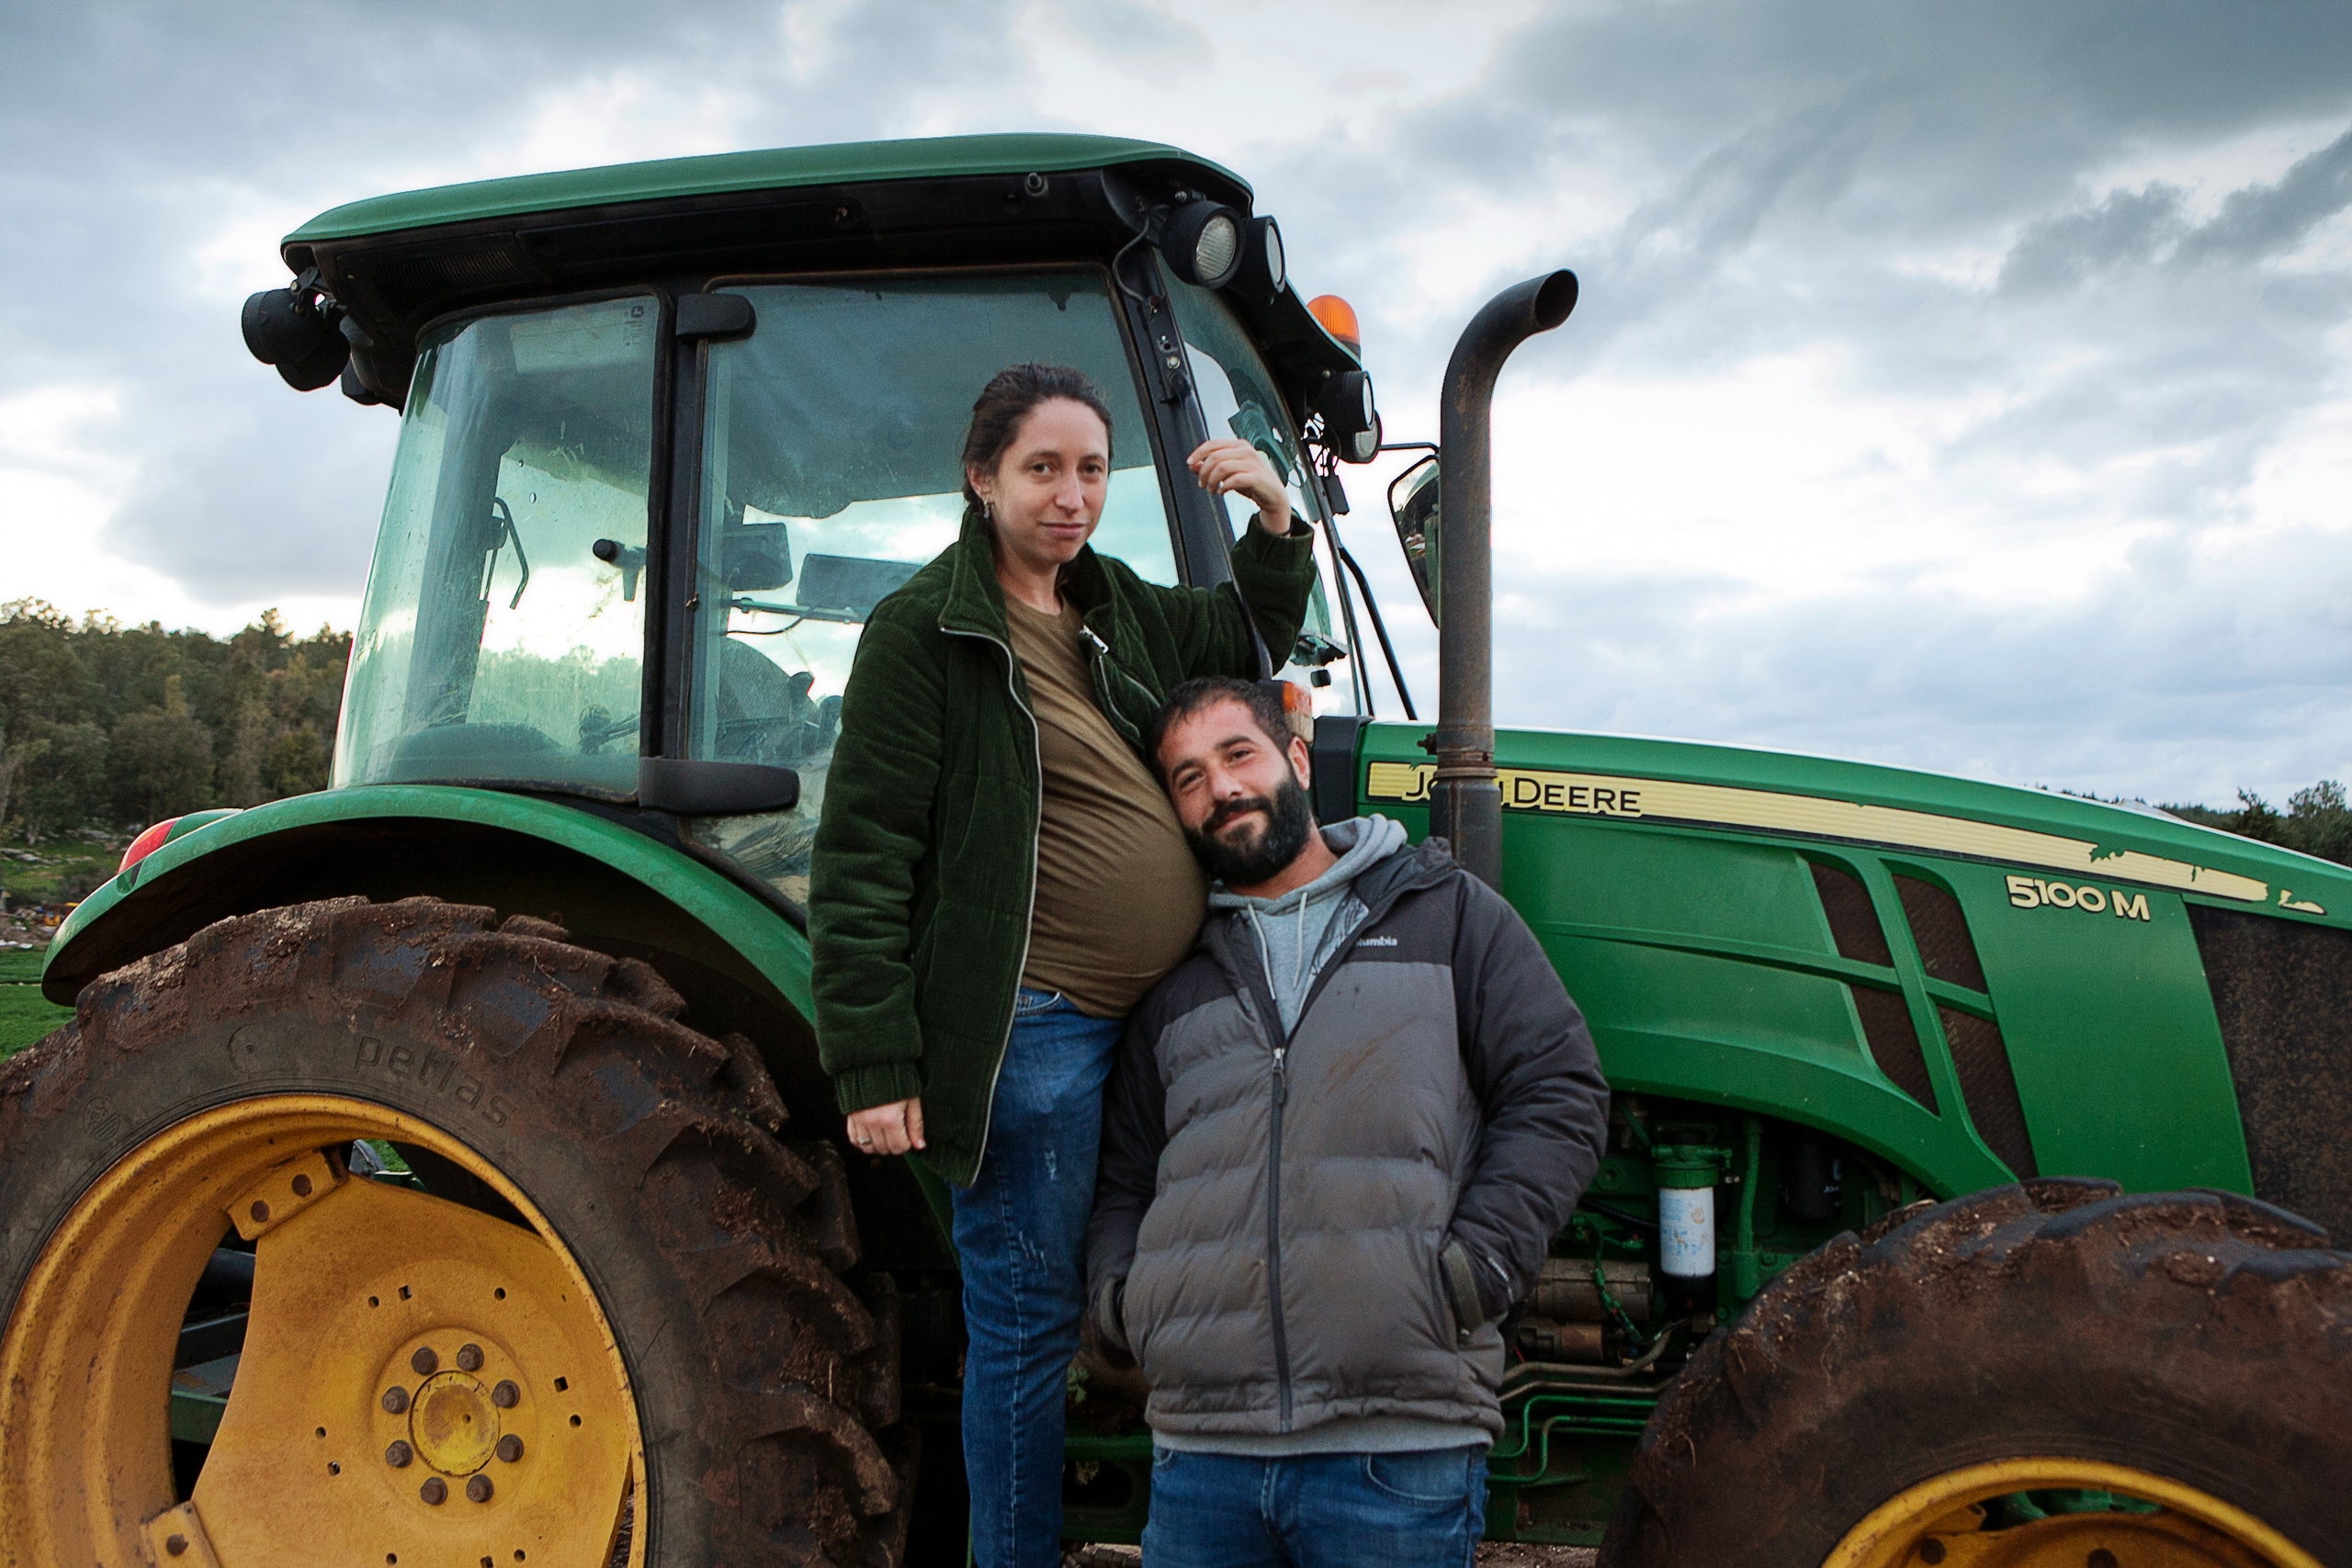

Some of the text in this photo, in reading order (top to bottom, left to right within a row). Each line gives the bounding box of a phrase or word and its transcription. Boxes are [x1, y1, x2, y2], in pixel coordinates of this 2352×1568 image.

[1514, 776, 1641, 813] DEERE
[2005, 874, 2107, 914] 5100
[353, 1034, 516, 1129] petlas
